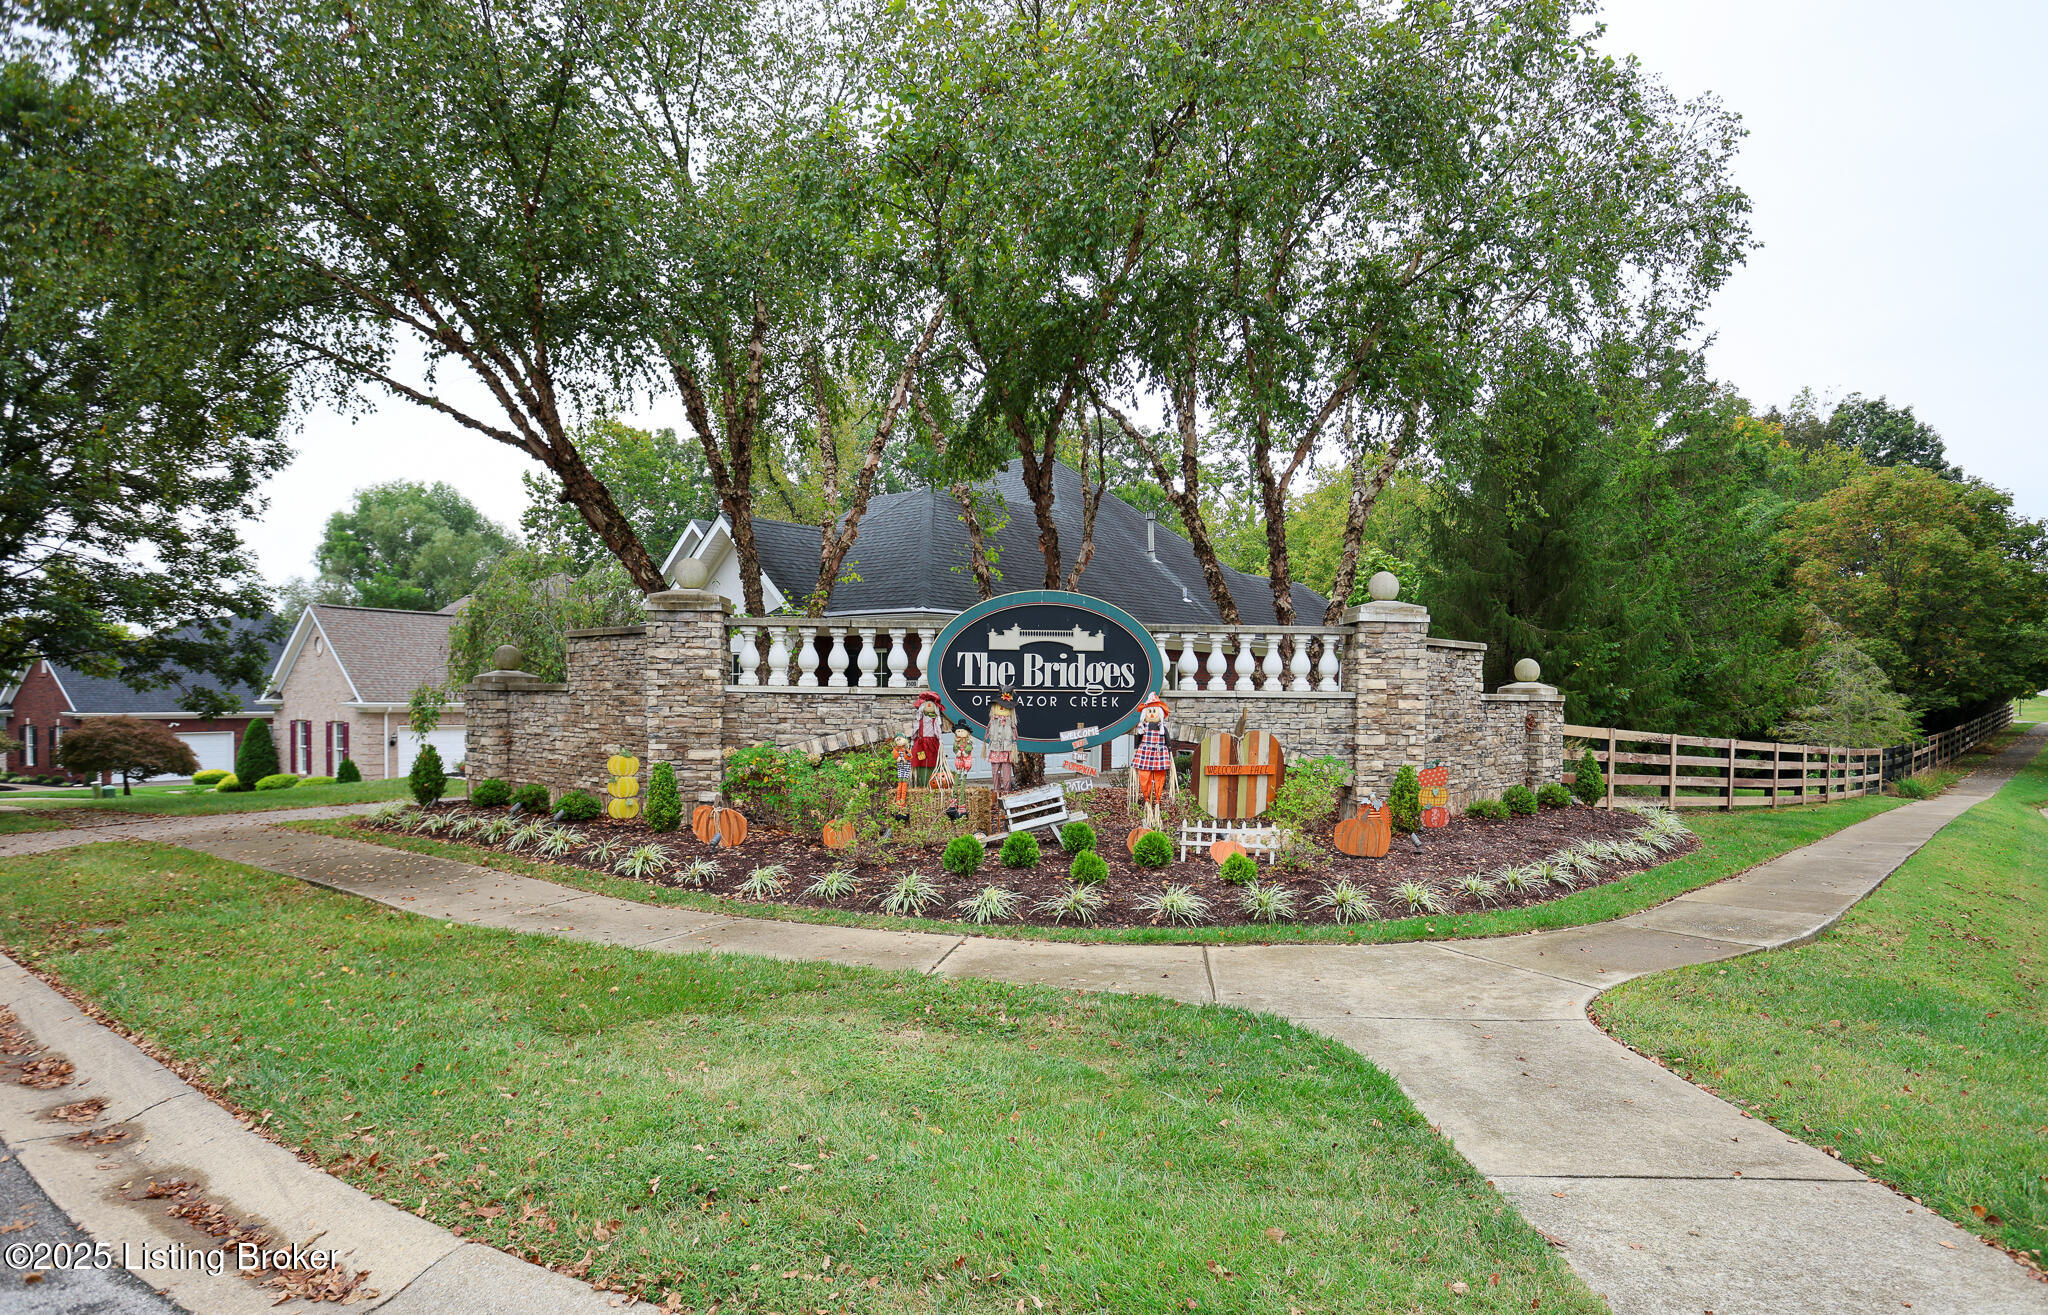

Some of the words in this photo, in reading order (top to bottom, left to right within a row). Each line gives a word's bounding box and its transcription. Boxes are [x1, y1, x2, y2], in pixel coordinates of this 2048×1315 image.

[956, 651, 1016, 687] The
[1022, 652, 1135, 696] Bridges
[1016, 696, 1058, 707] AZOR
[1069, 696, 1119, 707] CREEK
[1063, 728, 1099, 740] WELCOME
[1073, 752, 1087, 760] THE
[1063, 760, 1097, 776] PUMPKIN
[1206, 765, 1242, 774] WELCOME
[1066, 778, 1094, 792] PATCH
